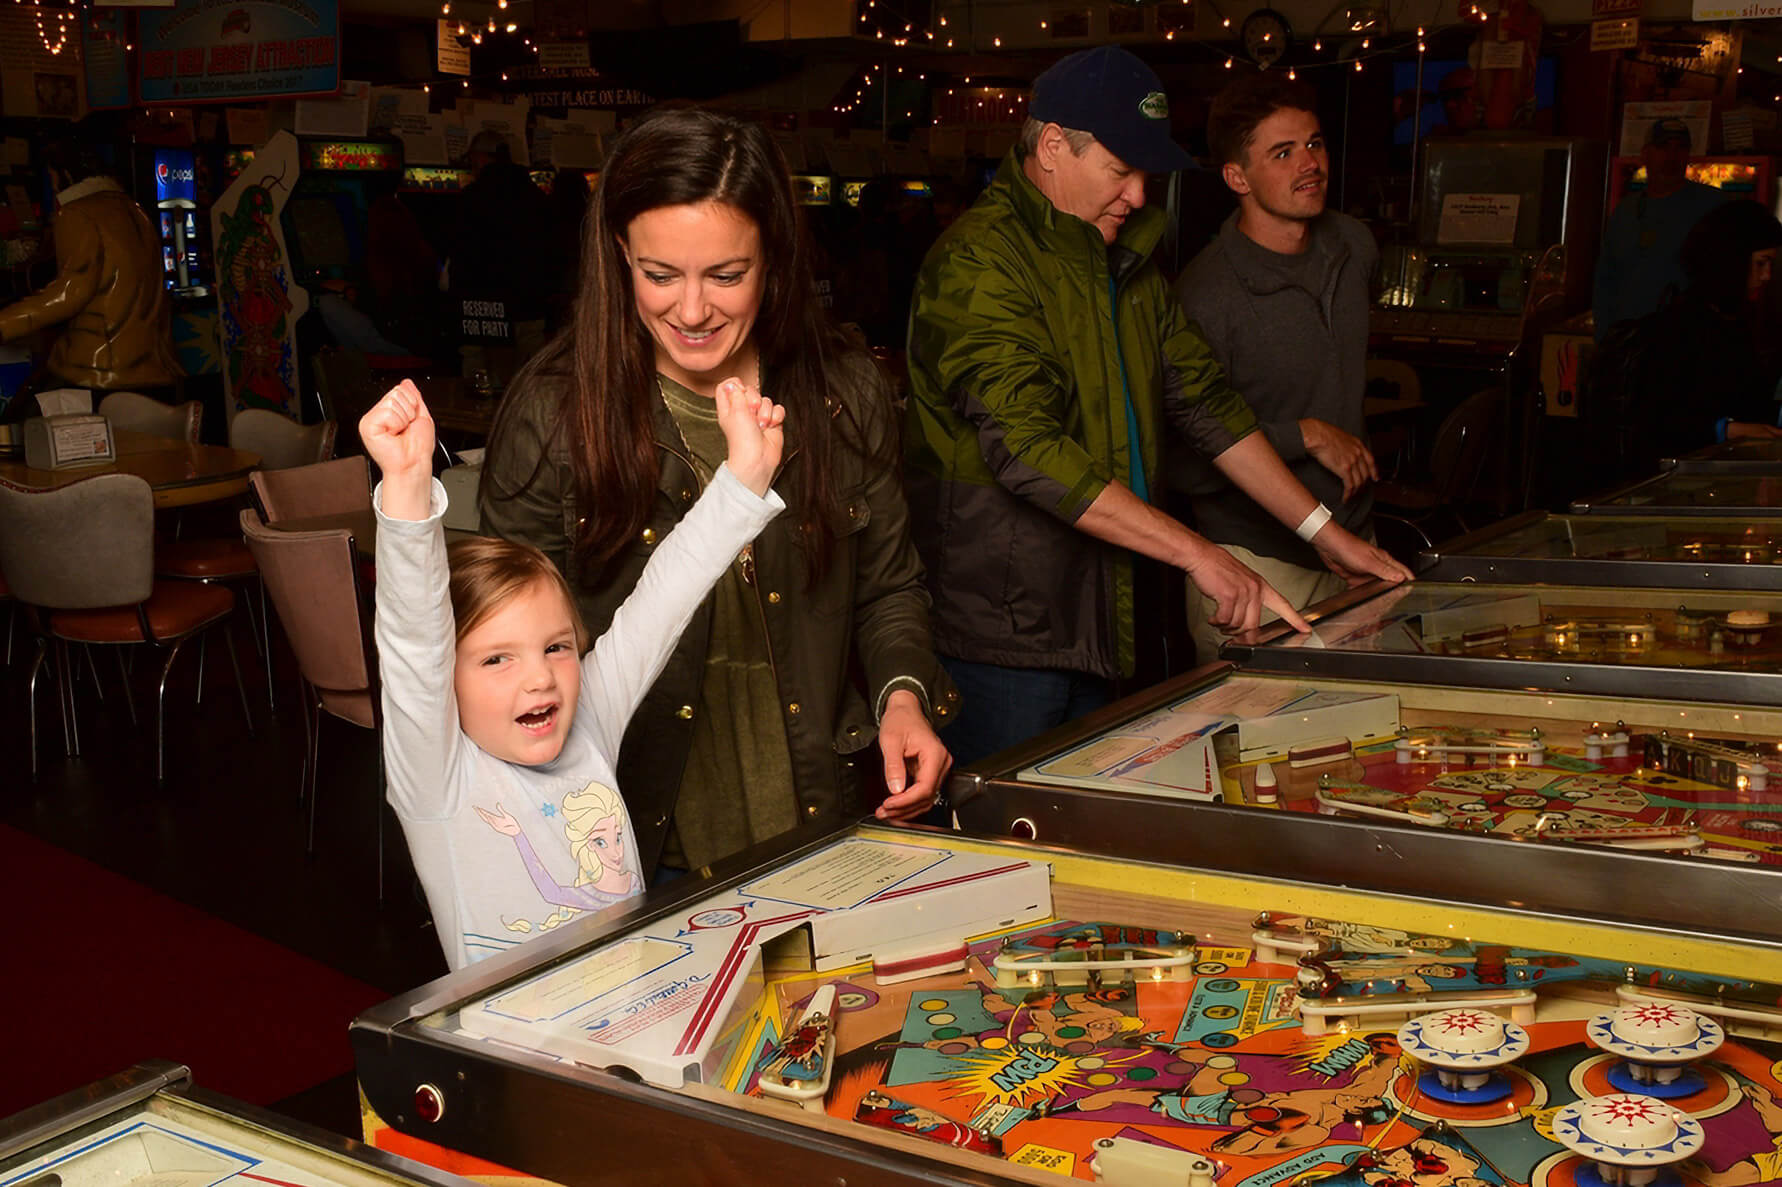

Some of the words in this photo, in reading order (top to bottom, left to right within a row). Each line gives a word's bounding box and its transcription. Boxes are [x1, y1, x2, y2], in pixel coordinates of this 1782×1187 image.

[176, 48, 204, 76] NEW
[207, 43, 252, 74] JERSEY
[256, 36, 336, 72] ATTRACTION
[561, 90, 597, 107] PLACE
[598, 90, 614, 105] ON
[463, 300, 504, 318] RESERVED
[462, 320, 480, 336] FOR
[482, 320, 510, 337] PARTY
[989, 1047, 1060, 1093] POW
[1303, 1152, 1326, 1164] ADD
[1251, 1162, 1302, 1187] ADVANCE
